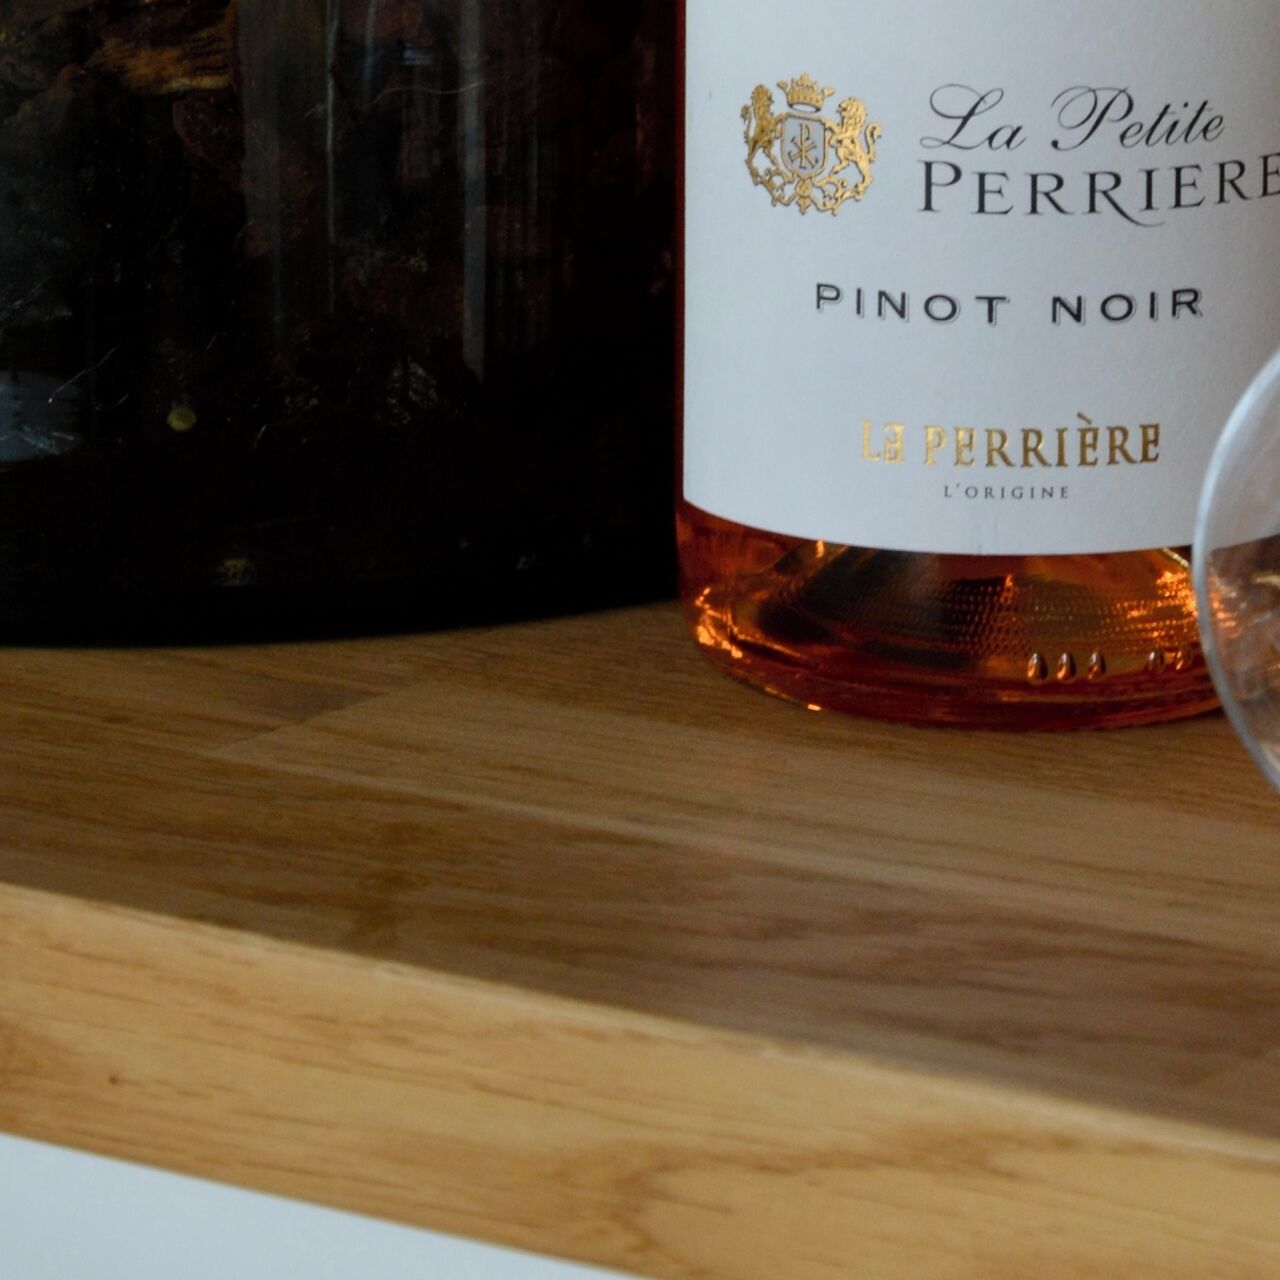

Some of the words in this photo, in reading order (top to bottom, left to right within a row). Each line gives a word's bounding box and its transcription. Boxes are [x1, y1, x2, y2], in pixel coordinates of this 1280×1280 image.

[918, 83, 1027, 151] La
[1049, 85, 1226, 152] Petite
[815, 282, 1011, 327] PINOT
[1050, 287, 1205, 326] NOIR
[923, 411, 1161, 468] PERRIÈRE
[943, 483, 1070, 500] L'ORIGINE
